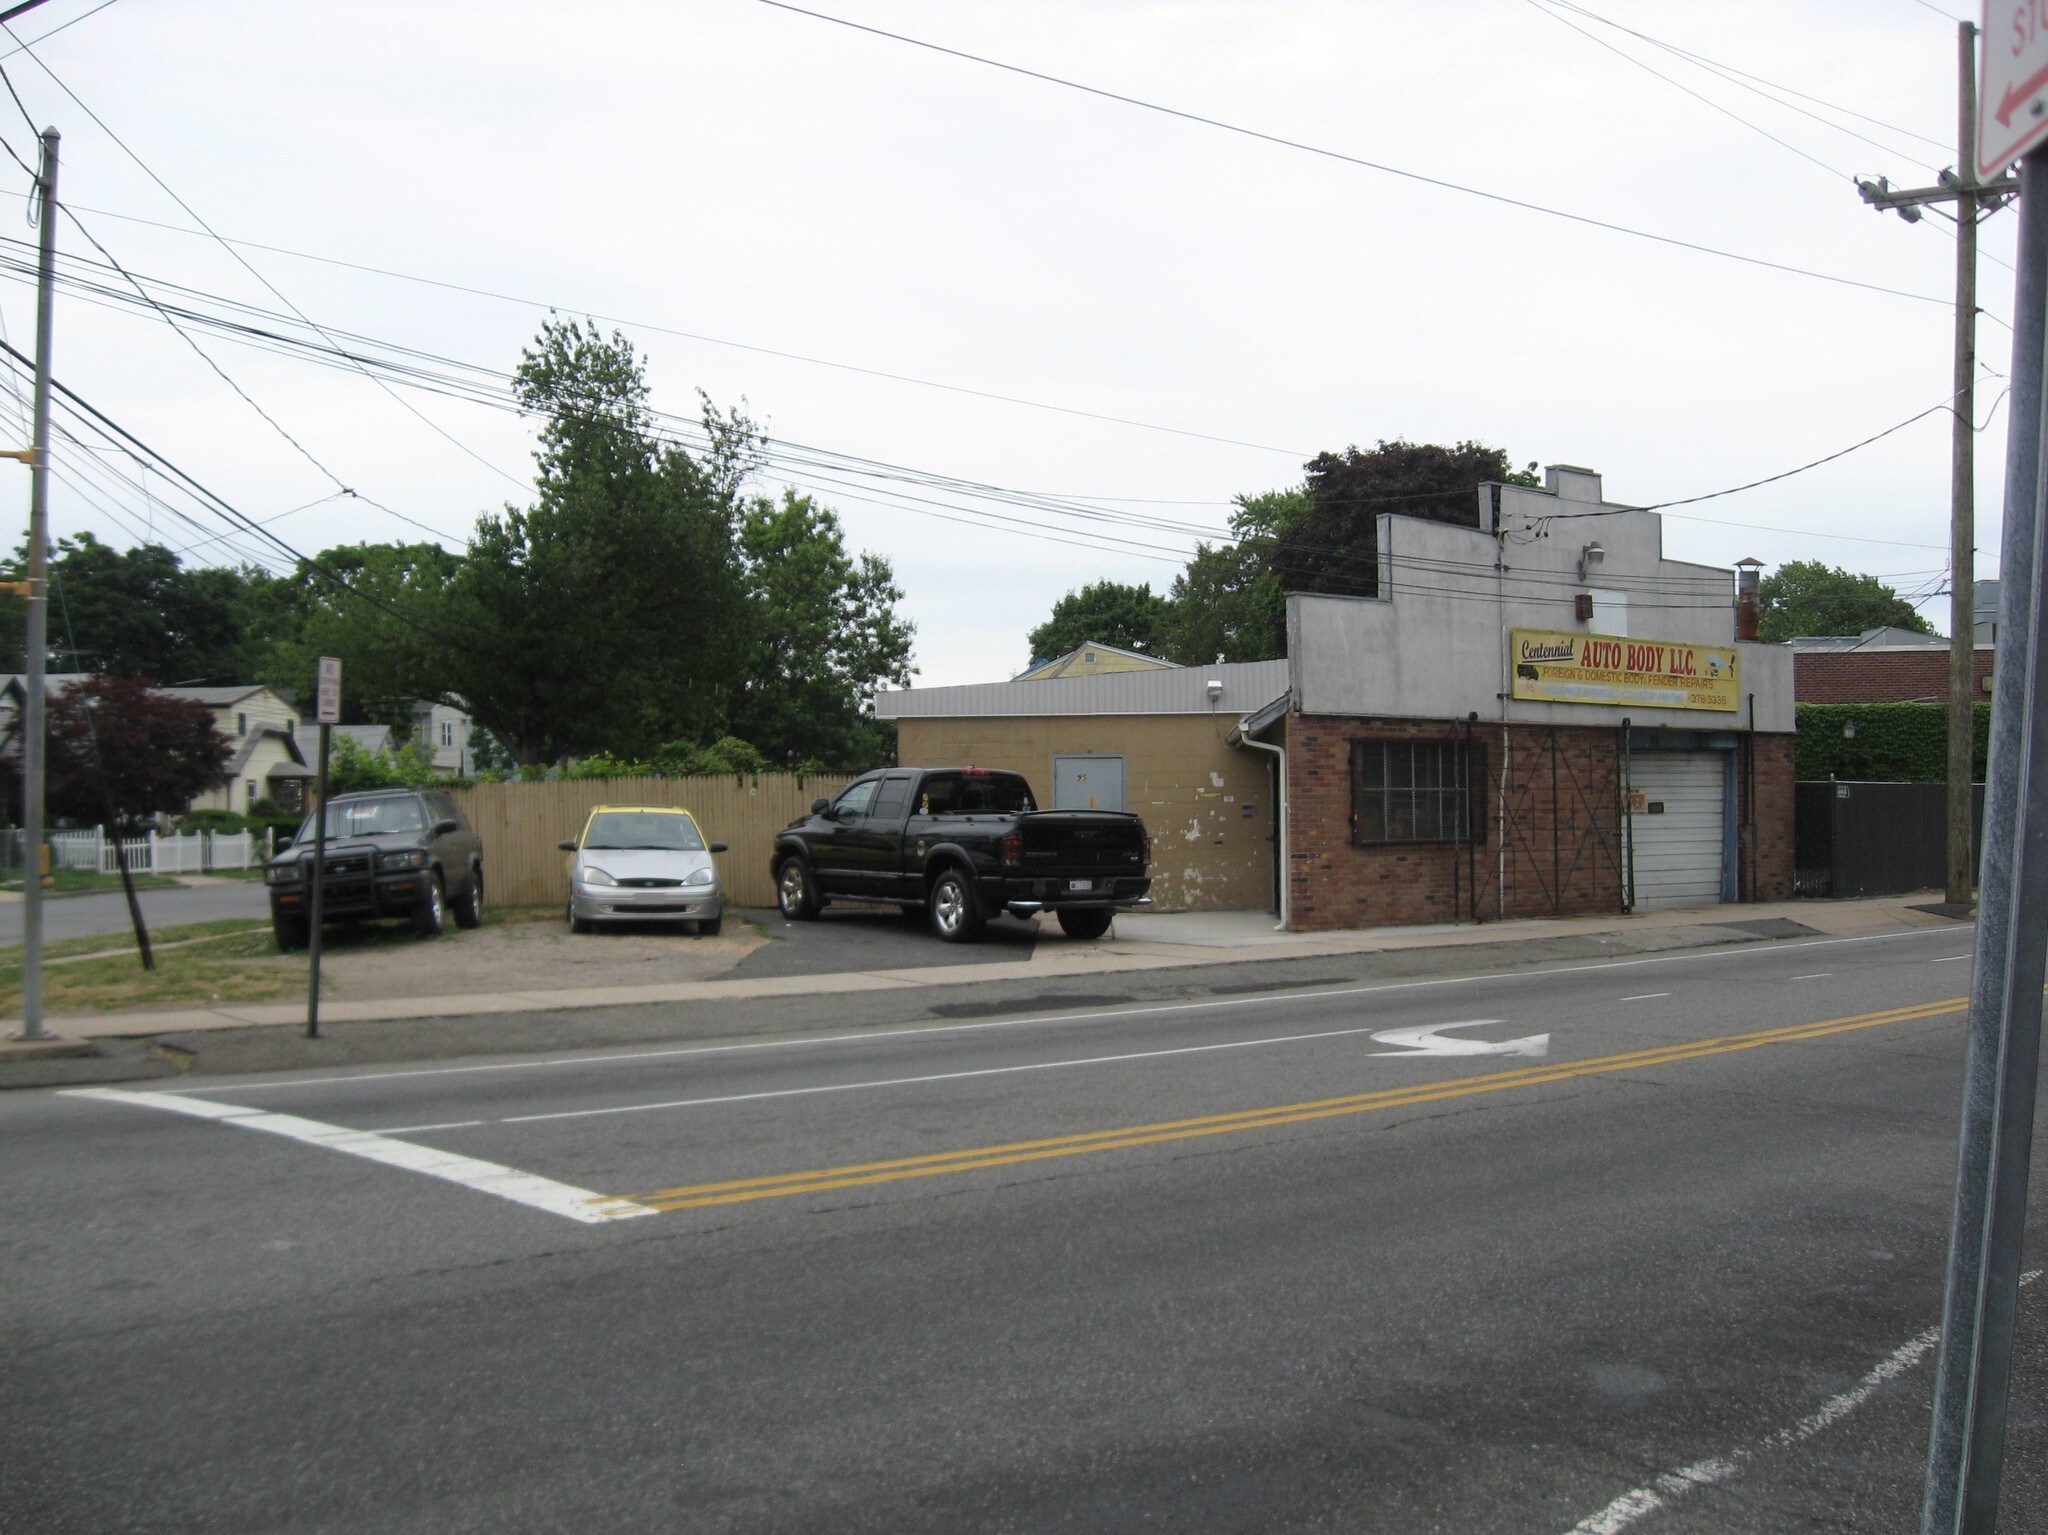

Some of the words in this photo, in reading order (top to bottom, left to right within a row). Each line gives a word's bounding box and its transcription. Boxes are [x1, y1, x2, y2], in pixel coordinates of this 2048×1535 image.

[1522, 638, 1574, 660] Centennial
[1580, 640, 1622, 669] AUTO
[1626, 644, 1665, 673] BODY
[1669, 647, 1697, 676] LLC.
[1542, 667, 1577, 680] FOREIGN
[1585, 669, 1622, 683] DOMESTIC
[1648, 674, 1678, 688] FENDER
[1680, 678, 1714, 690] REPAIRS
